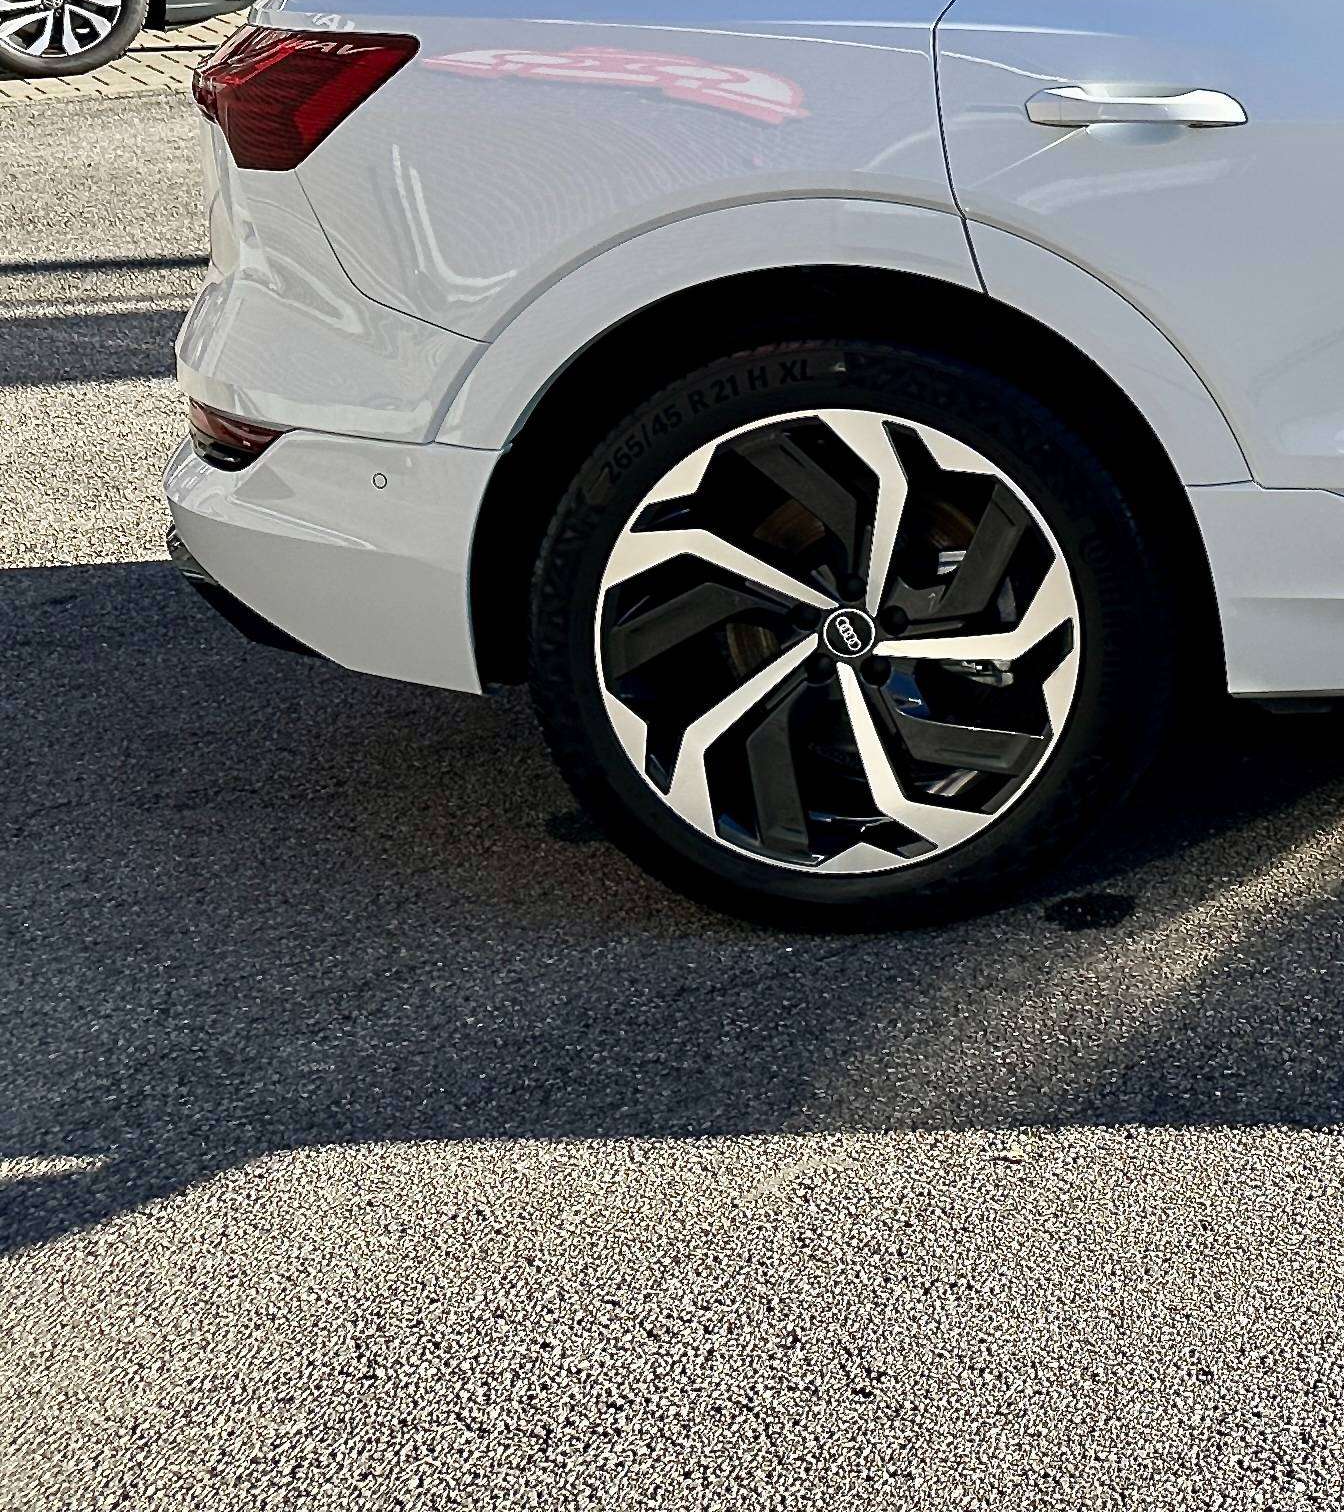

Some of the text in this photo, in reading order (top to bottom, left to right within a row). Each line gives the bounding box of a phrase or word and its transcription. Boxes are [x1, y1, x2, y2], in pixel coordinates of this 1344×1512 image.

[601, 359, 814, 484] 265/45 R 21 H XL
